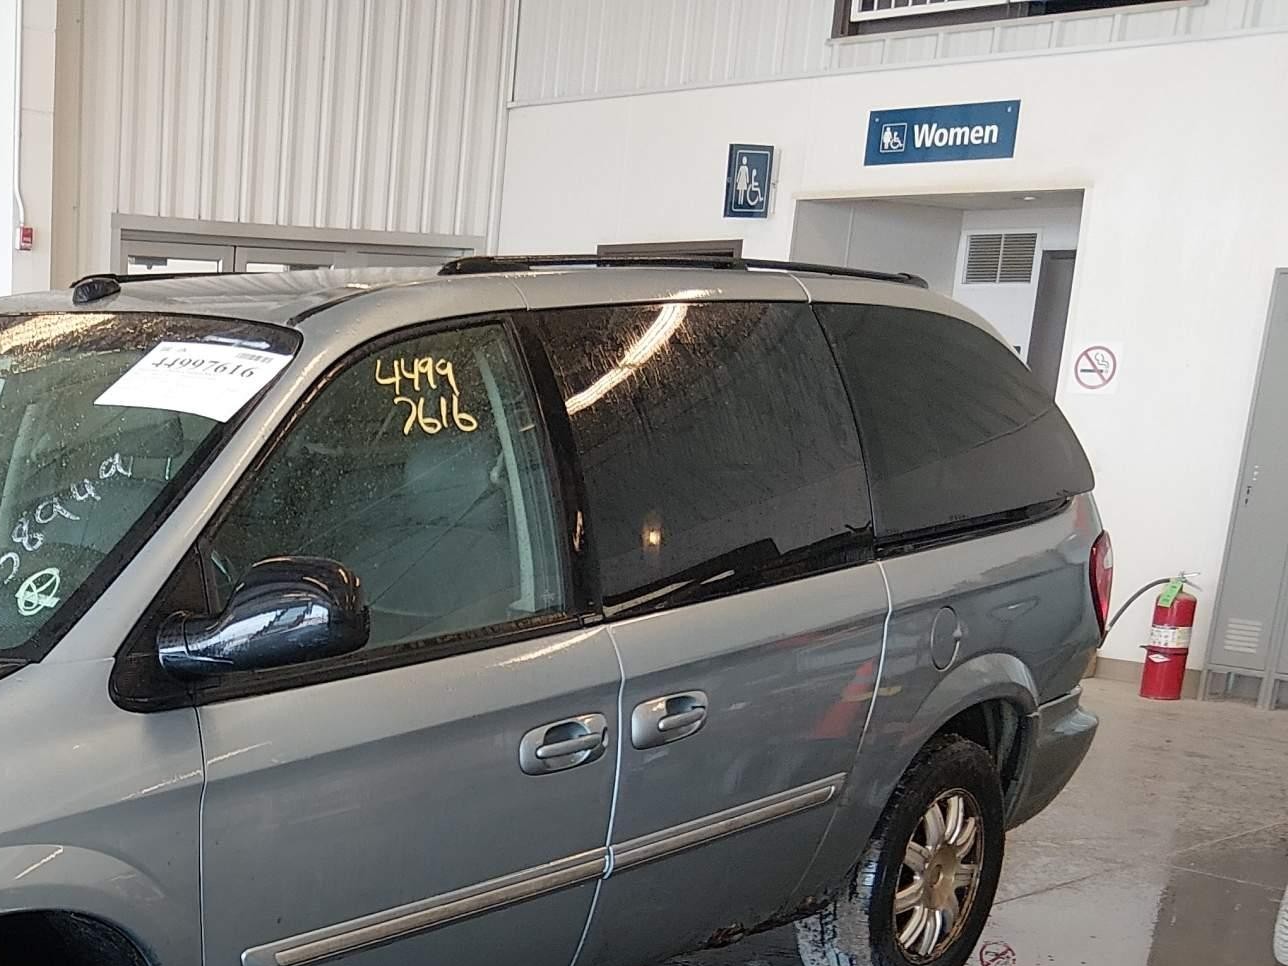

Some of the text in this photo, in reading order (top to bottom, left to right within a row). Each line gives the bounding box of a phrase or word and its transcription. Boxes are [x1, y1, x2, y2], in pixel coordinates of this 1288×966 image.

[913, 123, 999, 148] Women
[151, 356, 257, 378] 44997616
[375, 356, 460, 396] 4499
[393, 393, 479, 436] 7616
